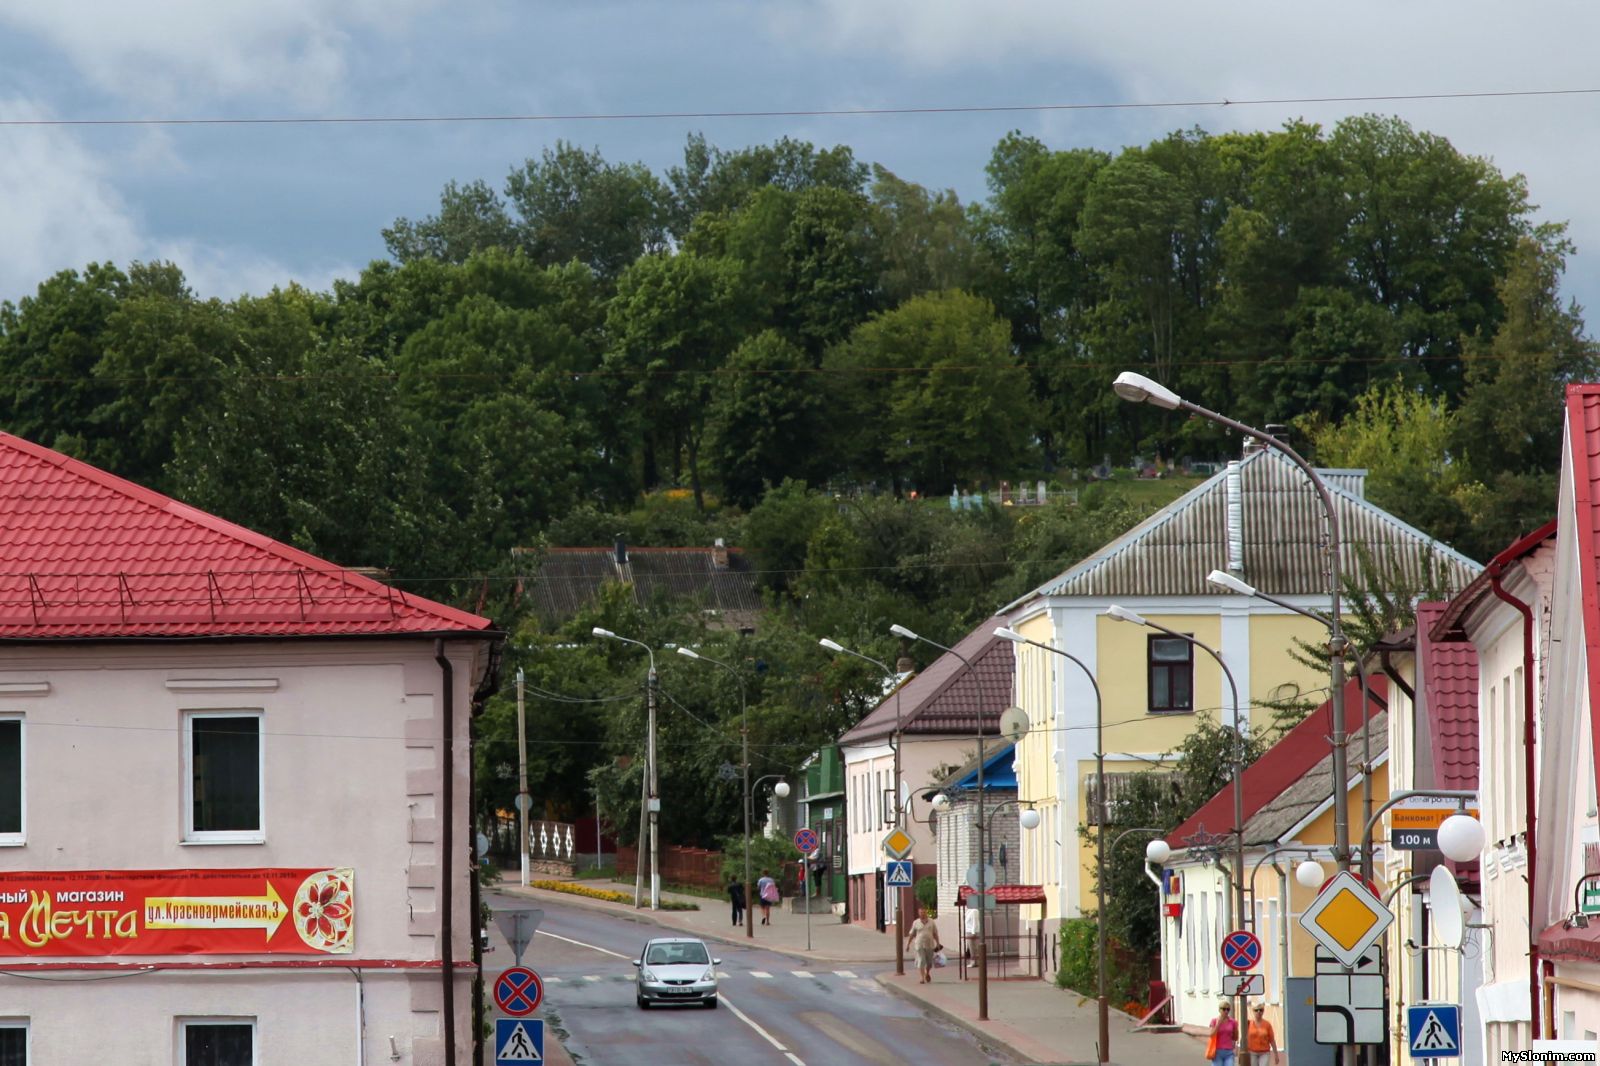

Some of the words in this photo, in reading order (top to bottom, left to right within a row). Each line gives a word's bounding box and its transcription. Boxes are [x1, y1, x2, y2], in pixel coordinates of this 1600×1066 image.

[1399, 834, 1421, 846] 100
[0, 888, 28, 903] ный
[56, 890, 124, 902] магазин
[19, 889, 138, 948] Мечта
